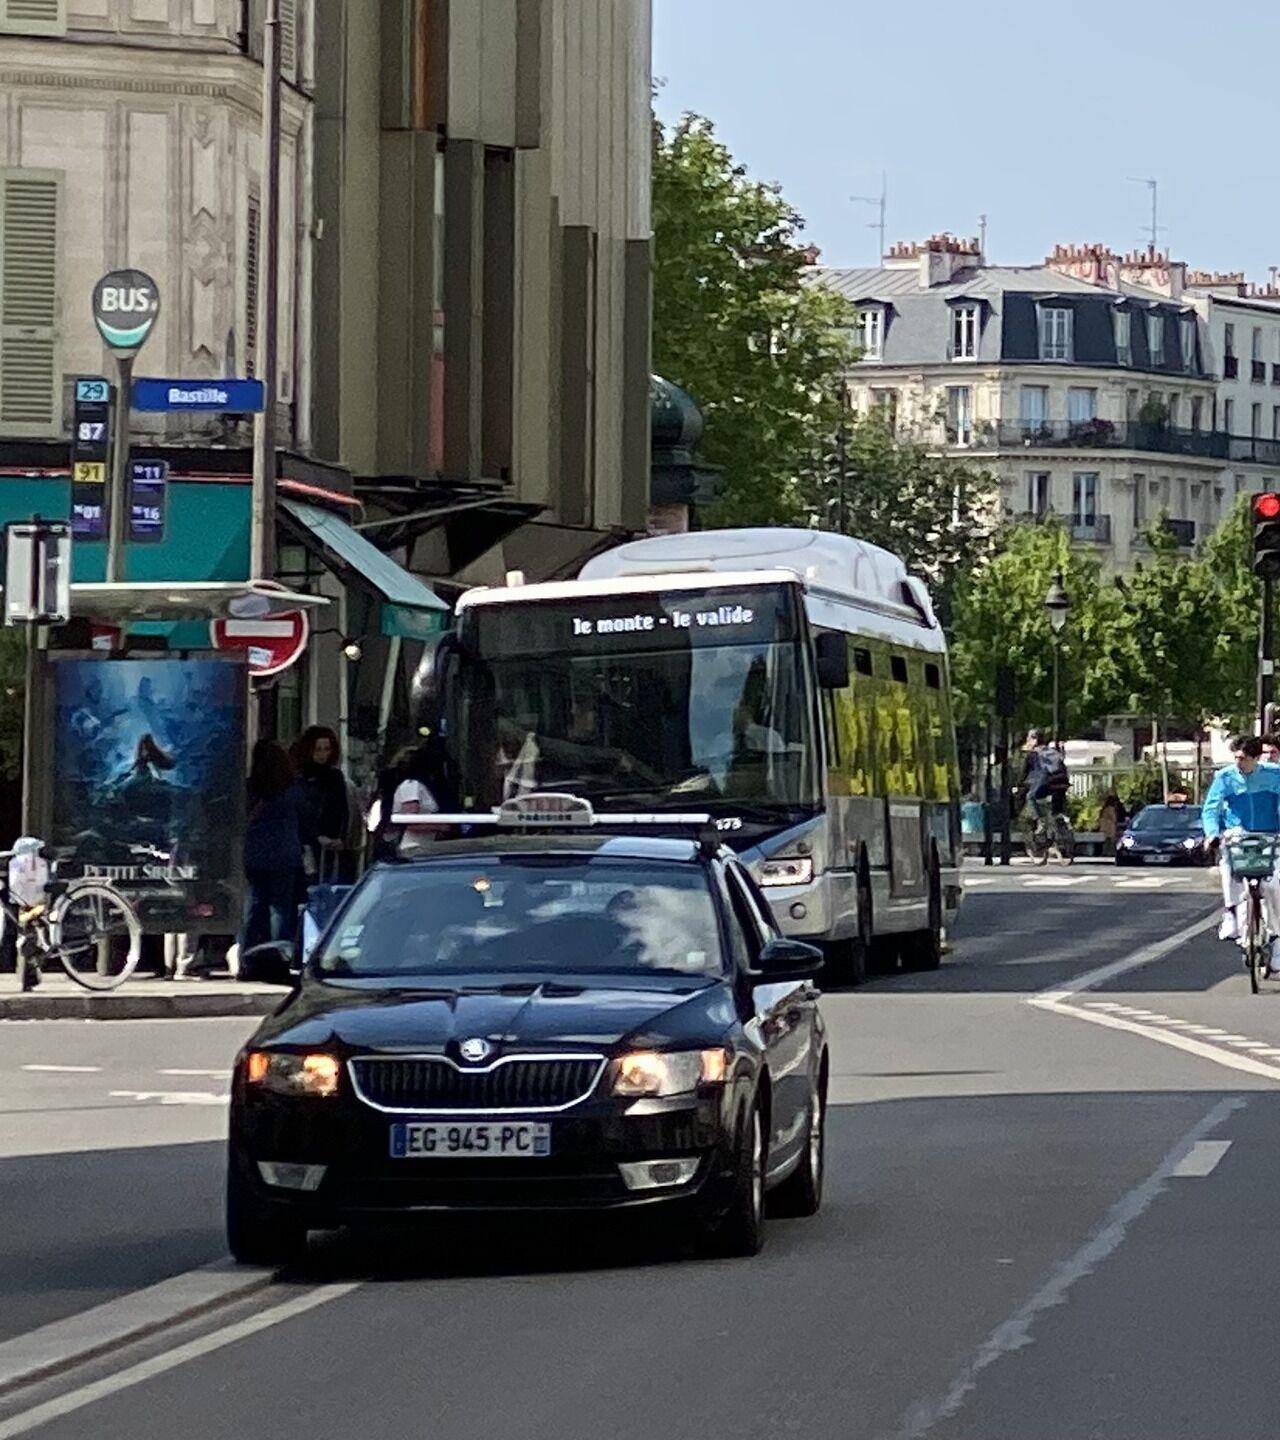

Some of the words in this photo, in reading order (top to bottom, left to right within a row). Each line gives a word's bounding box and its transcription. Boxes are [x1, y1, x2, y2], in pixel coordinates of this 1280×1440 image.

[101, 288, 151, 312] BUS
[81, 383, 105, 400] 29
[168, 387, 228, 404] Bastille
[78, 423, 105, 440] 87
[78, 464, 100, 480] 91
[597, 614, 655, 634] monte
[696, 605, 754, 626] valide
[408, 1126, 530, 1153] EG-945-PC
